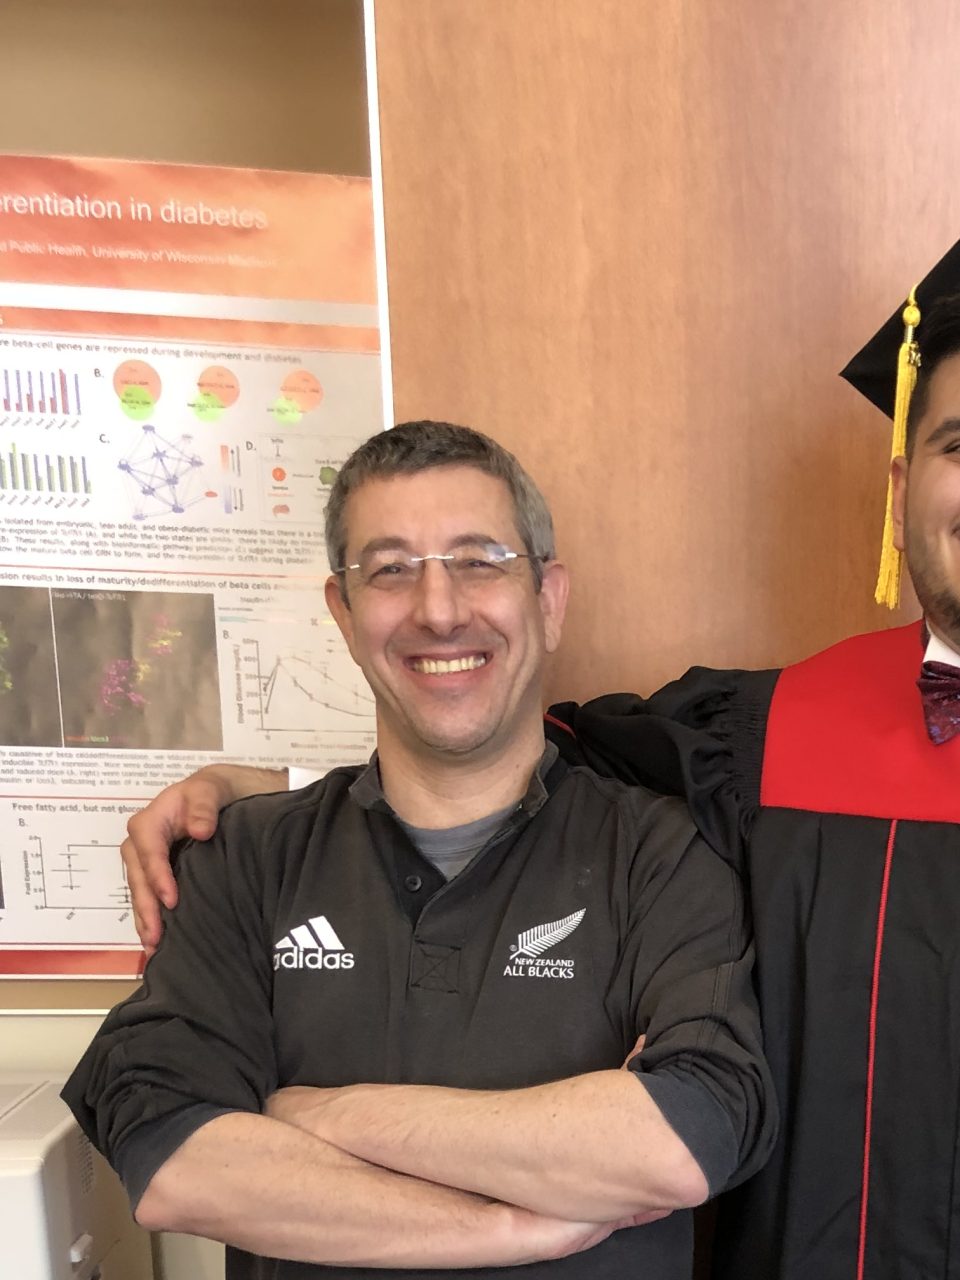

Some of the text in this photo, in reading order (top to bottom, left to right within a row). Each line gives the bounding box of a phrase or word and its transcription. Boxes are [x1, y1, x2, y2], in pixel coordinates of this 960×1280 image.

[0, 191, 268, 229] rentiation in diabetes
[92, 245, 149, 262] University
[151, 250, 162, 262] of
[56, 342, 82, 351] genes
[103, 344, 148, 355] repressed
[151, 347, 181, 358] during
[183, 349, 242, 360] development
[244, 352, 261, 361] and
[21, 572, 53, 582] results
[55, 573, 64, 582] in
[67, 574, 84, 583] loss
[86, 575, 95, 584] of
[218, 580, 227, 589] of
[229, 581, 249, 590] beta
[251, 581, 272, 591] cells
[12, 803, 33, 811] Free
[36, 803, 57, 813] fatty
[83, 803, 100, 812] but
[101, 805, 117, 813] not
[514, 957, 575, 968] NEW ZEALAND
[503, 964, 575, 979] ALL BLACKS
